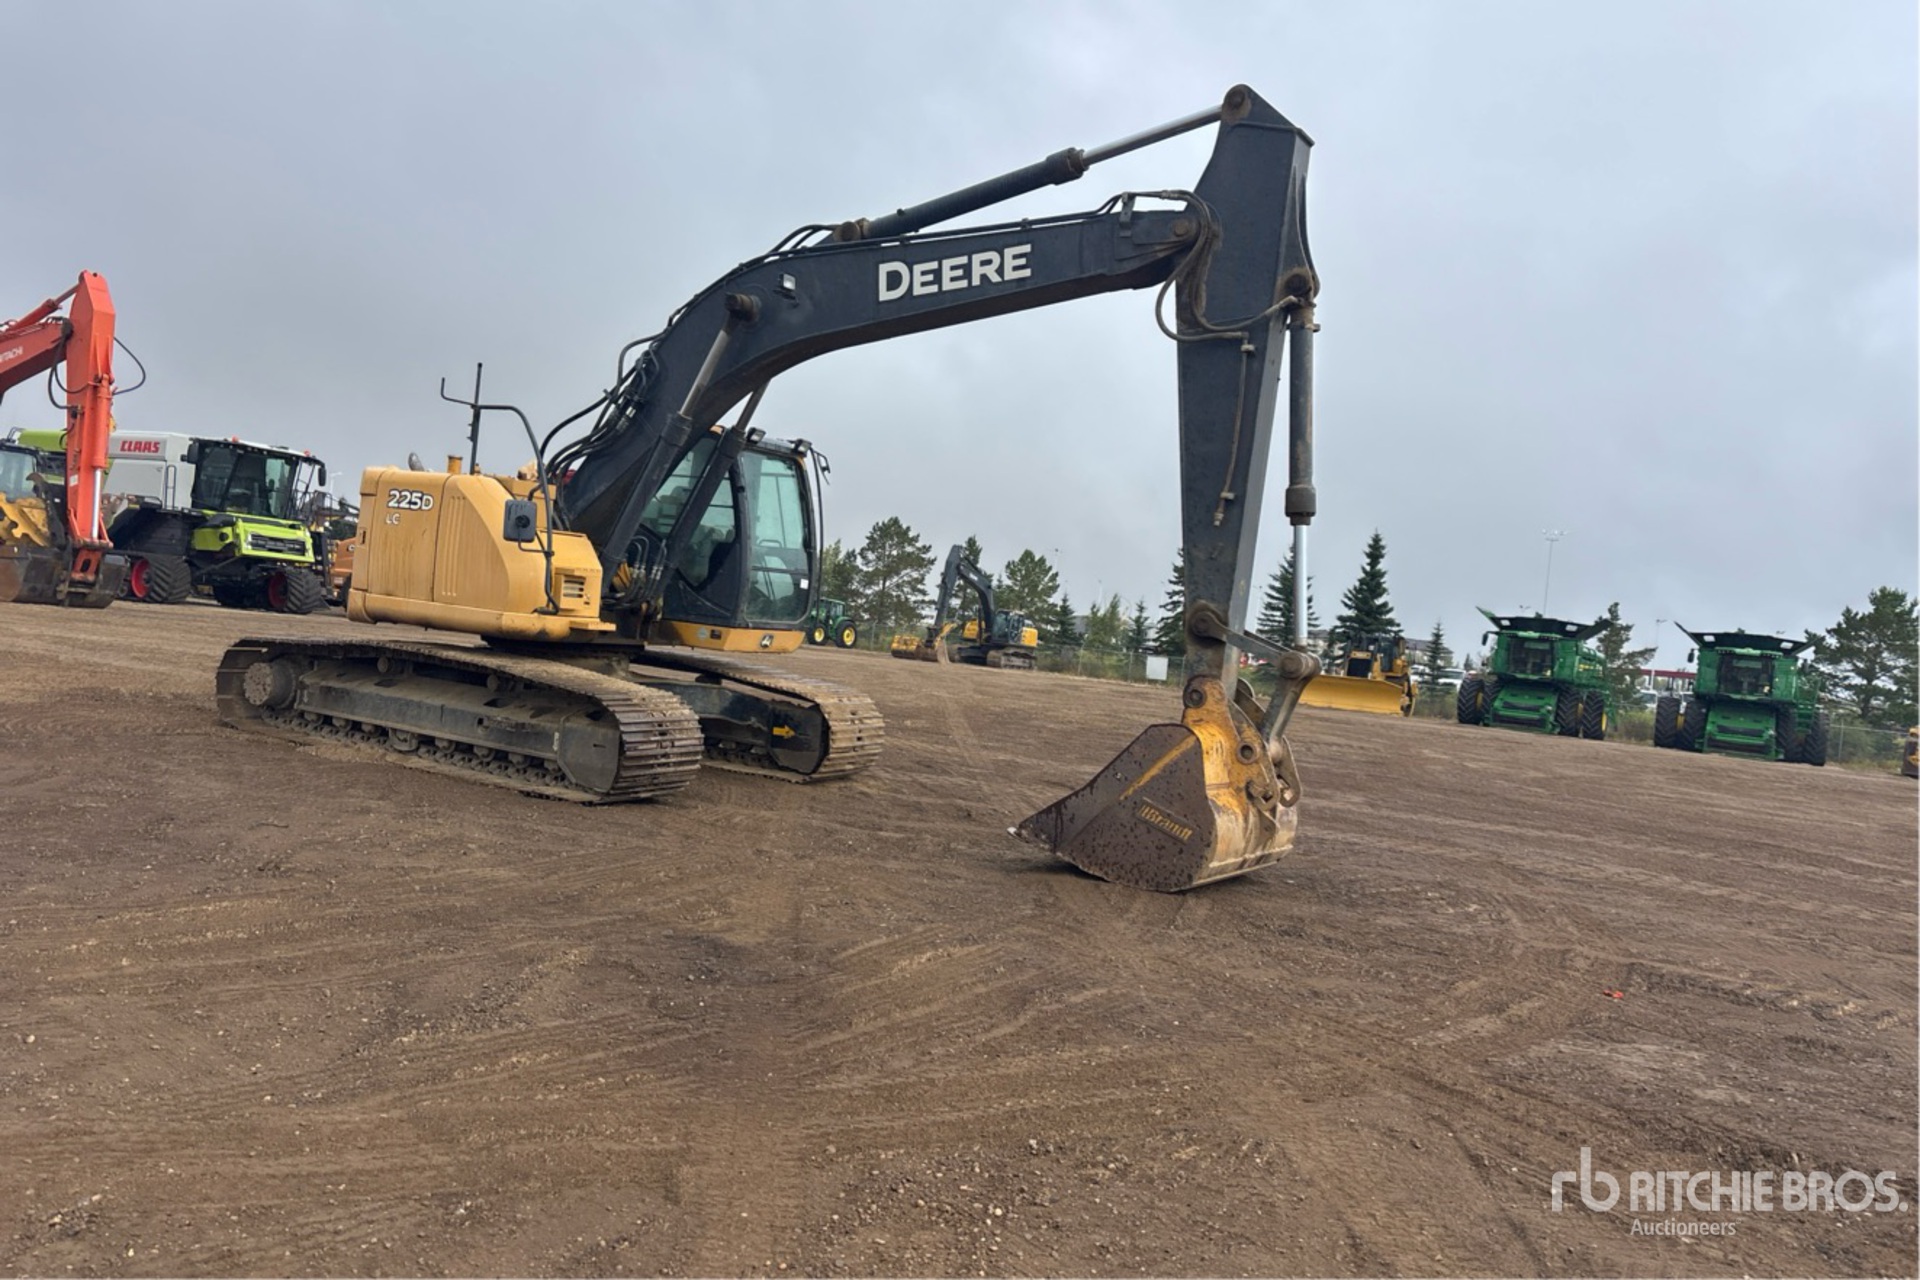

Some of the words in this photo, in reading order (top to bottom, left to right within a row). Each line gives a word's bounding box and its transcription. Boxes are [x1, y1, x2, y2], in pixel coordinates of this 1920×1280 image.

[879, 244, 1031, 302] DEERE
[120, 440, 161, 453] CLAAS
[387, 489, 434, 511] 225D
[385, 512, 401, 525] LC
